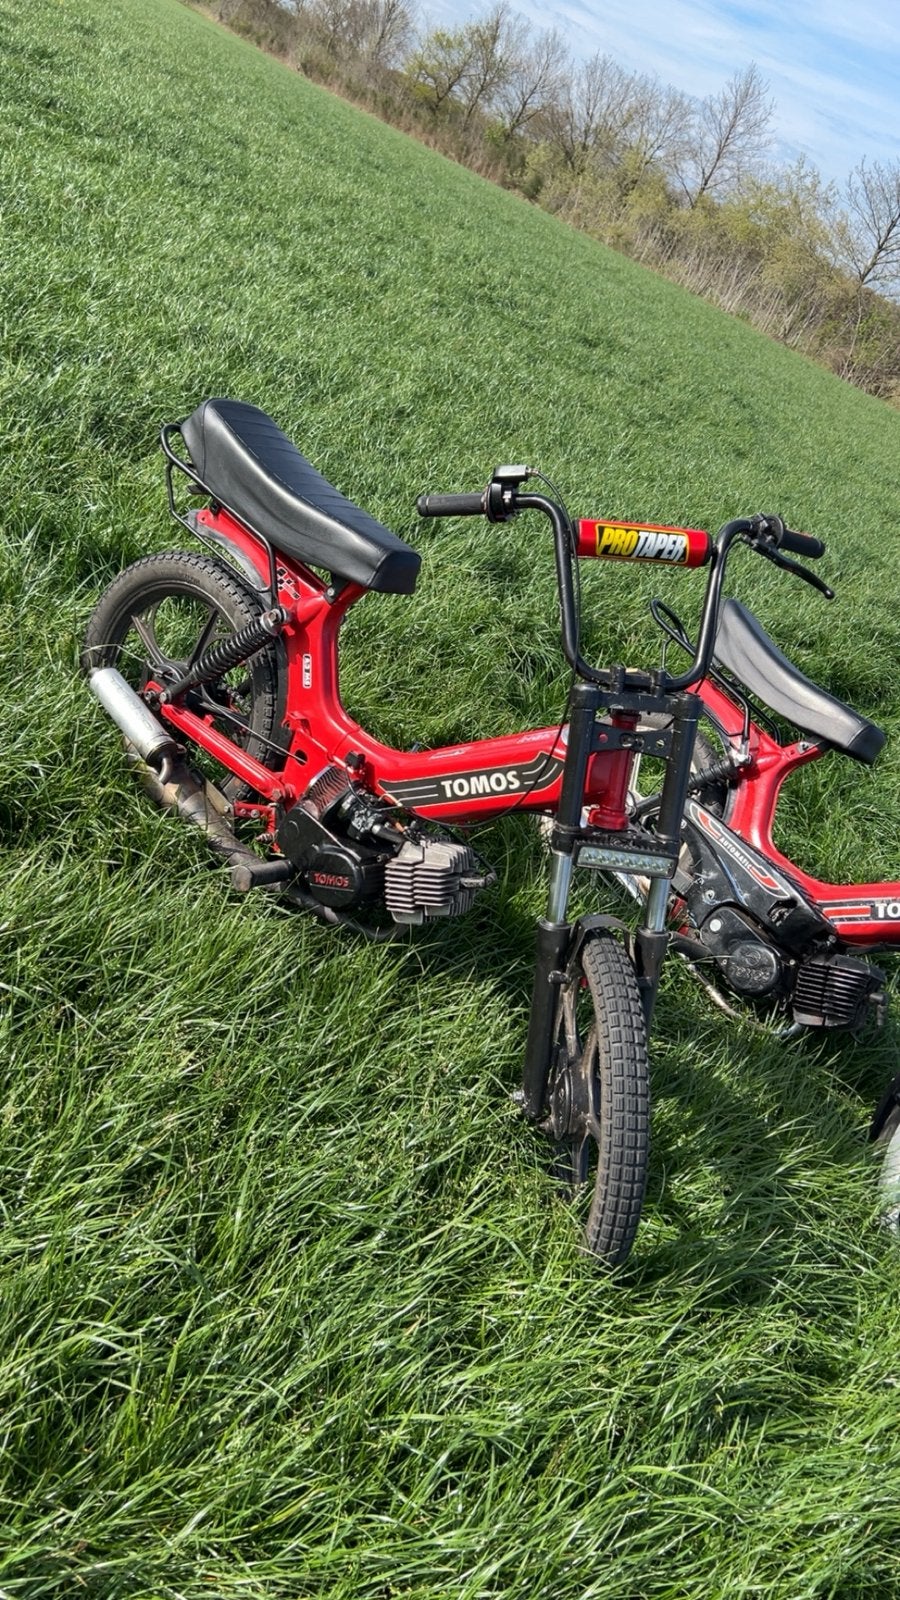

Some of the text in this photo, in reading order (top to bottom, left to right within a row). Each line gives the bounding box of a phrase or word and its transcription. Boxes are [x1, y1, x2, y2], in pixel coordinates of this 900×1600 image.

[599, 527, 687, 562] PROTAPER
[441, 770, 521, 799] TOMOS
[719, 837, 752, 870] AUTOMATIC
[314, 873, 350, 888] TOMOS
[875, 903, 900, 919] TO
